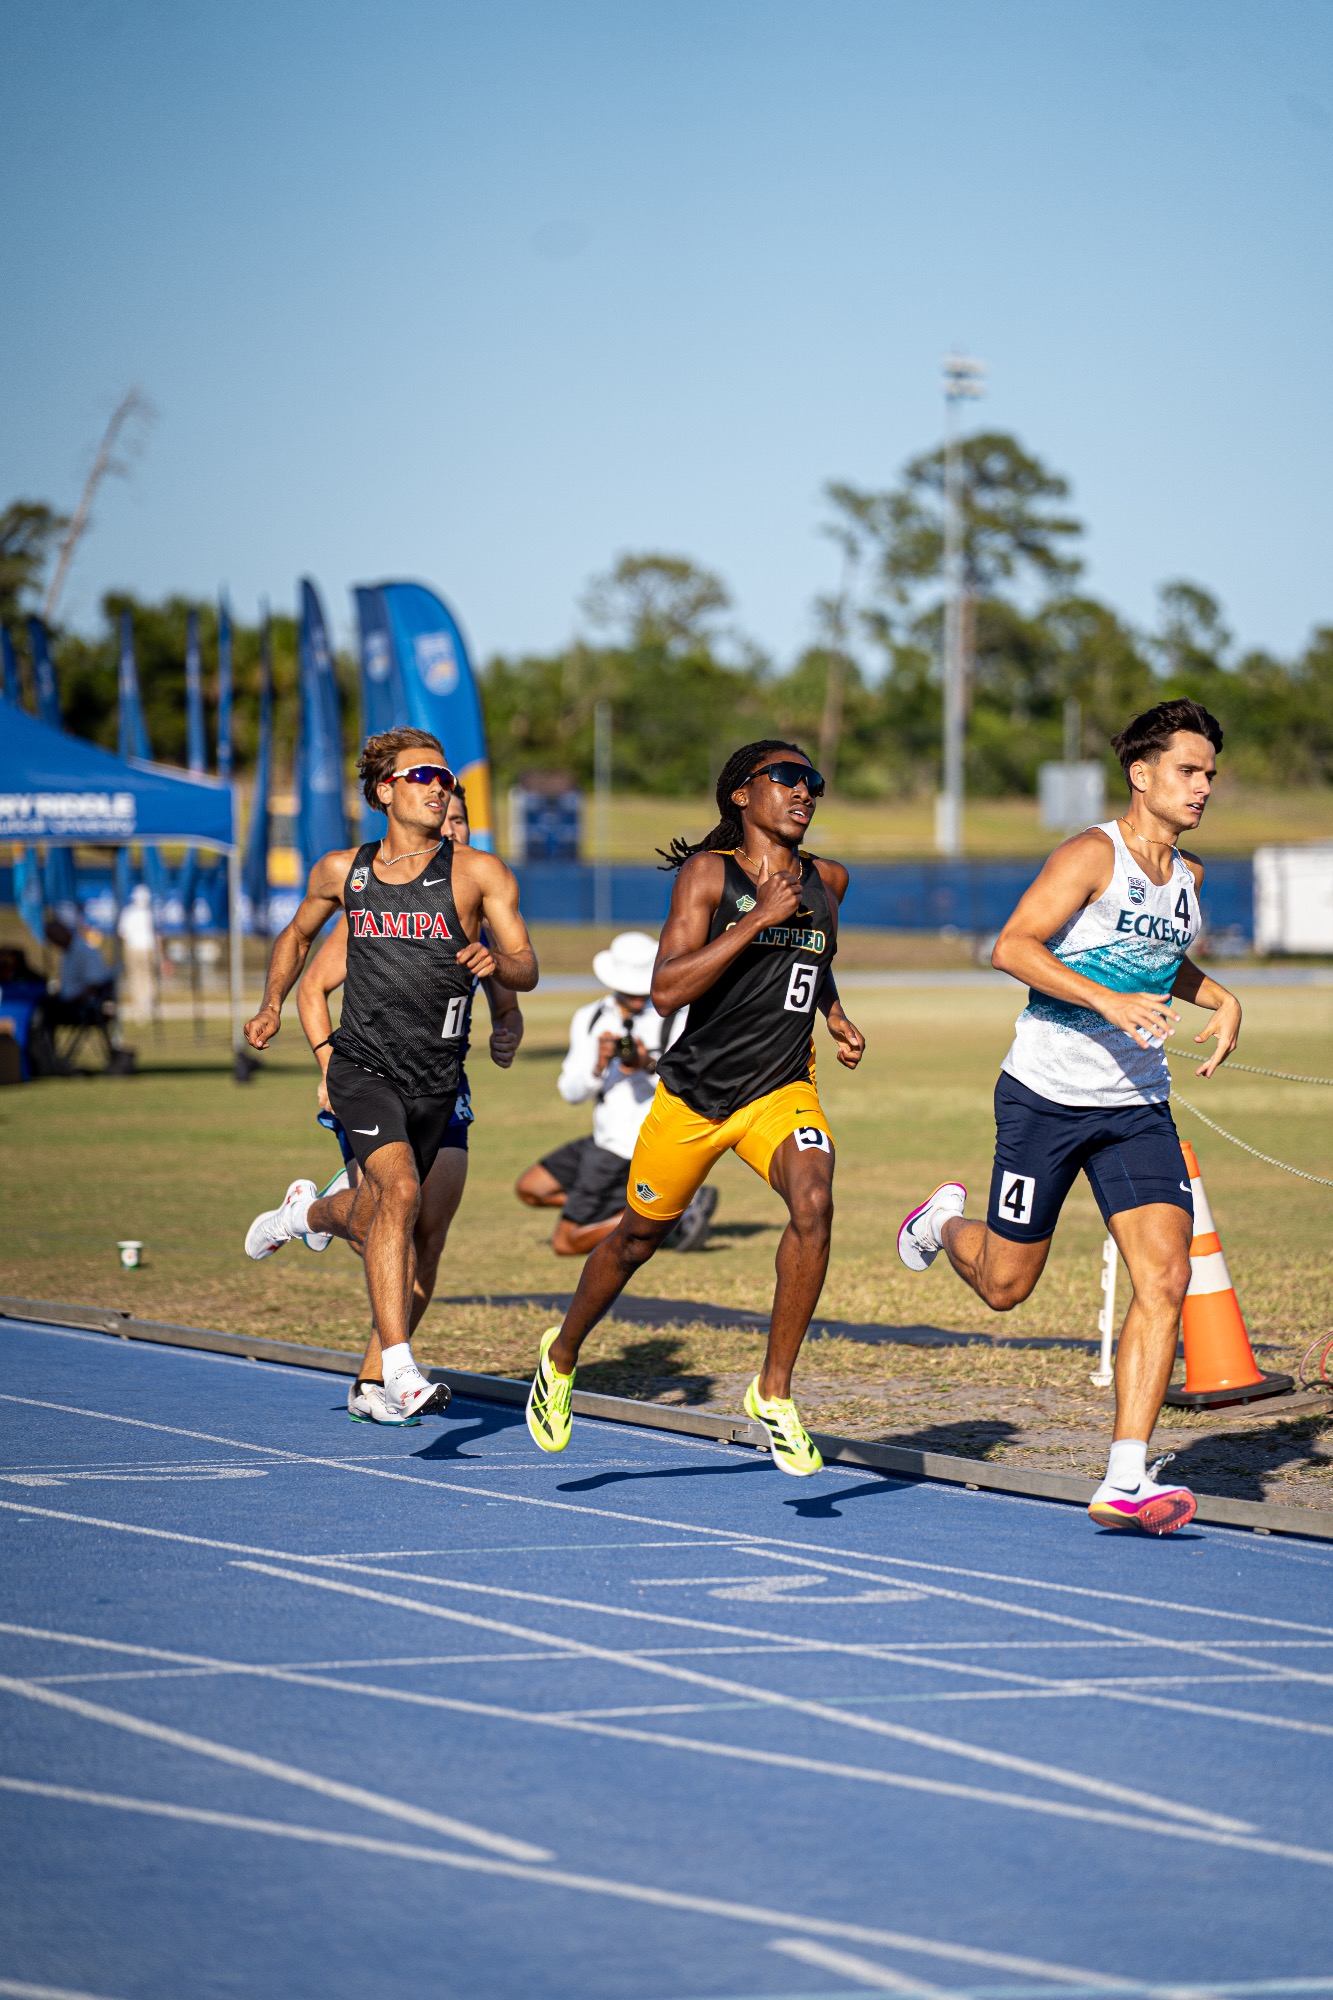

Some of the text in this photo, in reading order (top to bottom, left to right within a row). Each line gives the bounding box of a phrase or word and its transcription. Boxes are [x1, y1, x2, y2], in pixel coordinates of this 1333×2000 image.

[350, 908, 452, 940] TAMPA
[1174, 887, 1191, 929] 4
[791, 929, 827, 954] LEO
[790, 967, 814, 1009] 5
[451, 999, 463, 1035] 1
[1003, 1178, 1026, 1220] 4
